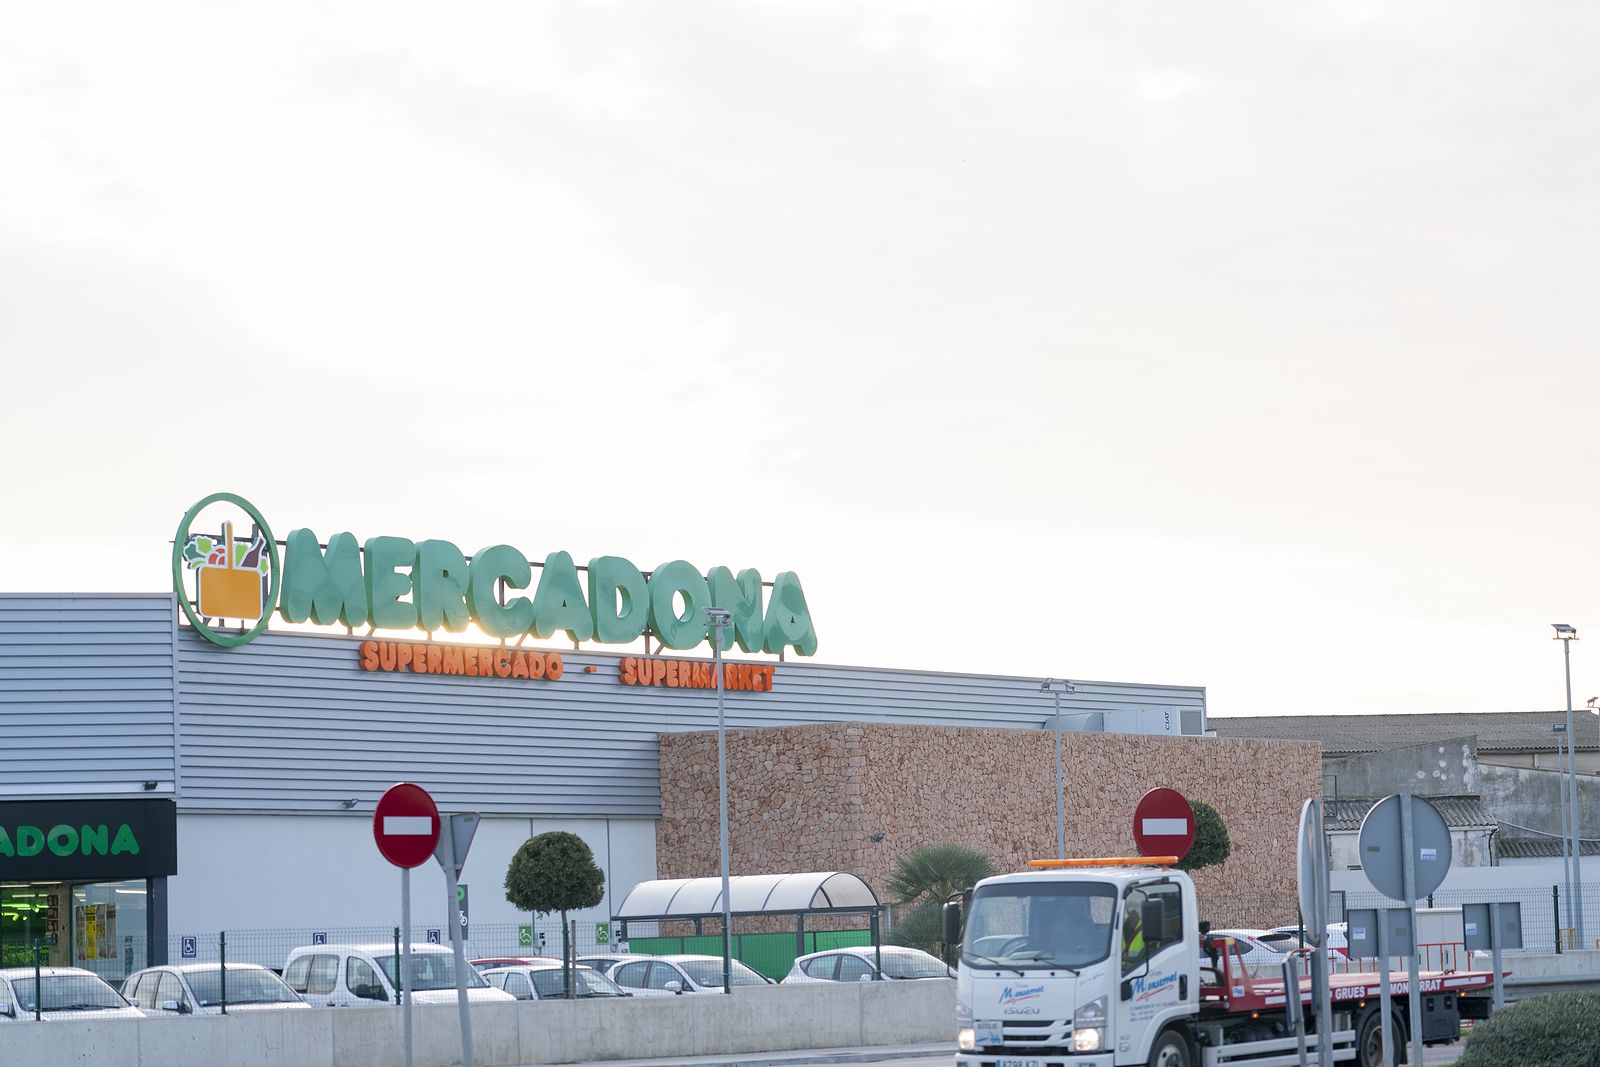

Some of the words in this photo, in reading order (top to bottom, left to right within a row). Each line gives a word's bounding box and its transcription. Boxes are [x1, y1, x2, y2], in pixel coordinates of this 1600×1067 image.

[280, 527, 818, 657] MERCADONA
[358, 640, 564, 682] SUPERMERCADO
[1335, 986, 1365, 1000] GRUES
[1004, 1006, 1041, 1015] ISUZU
